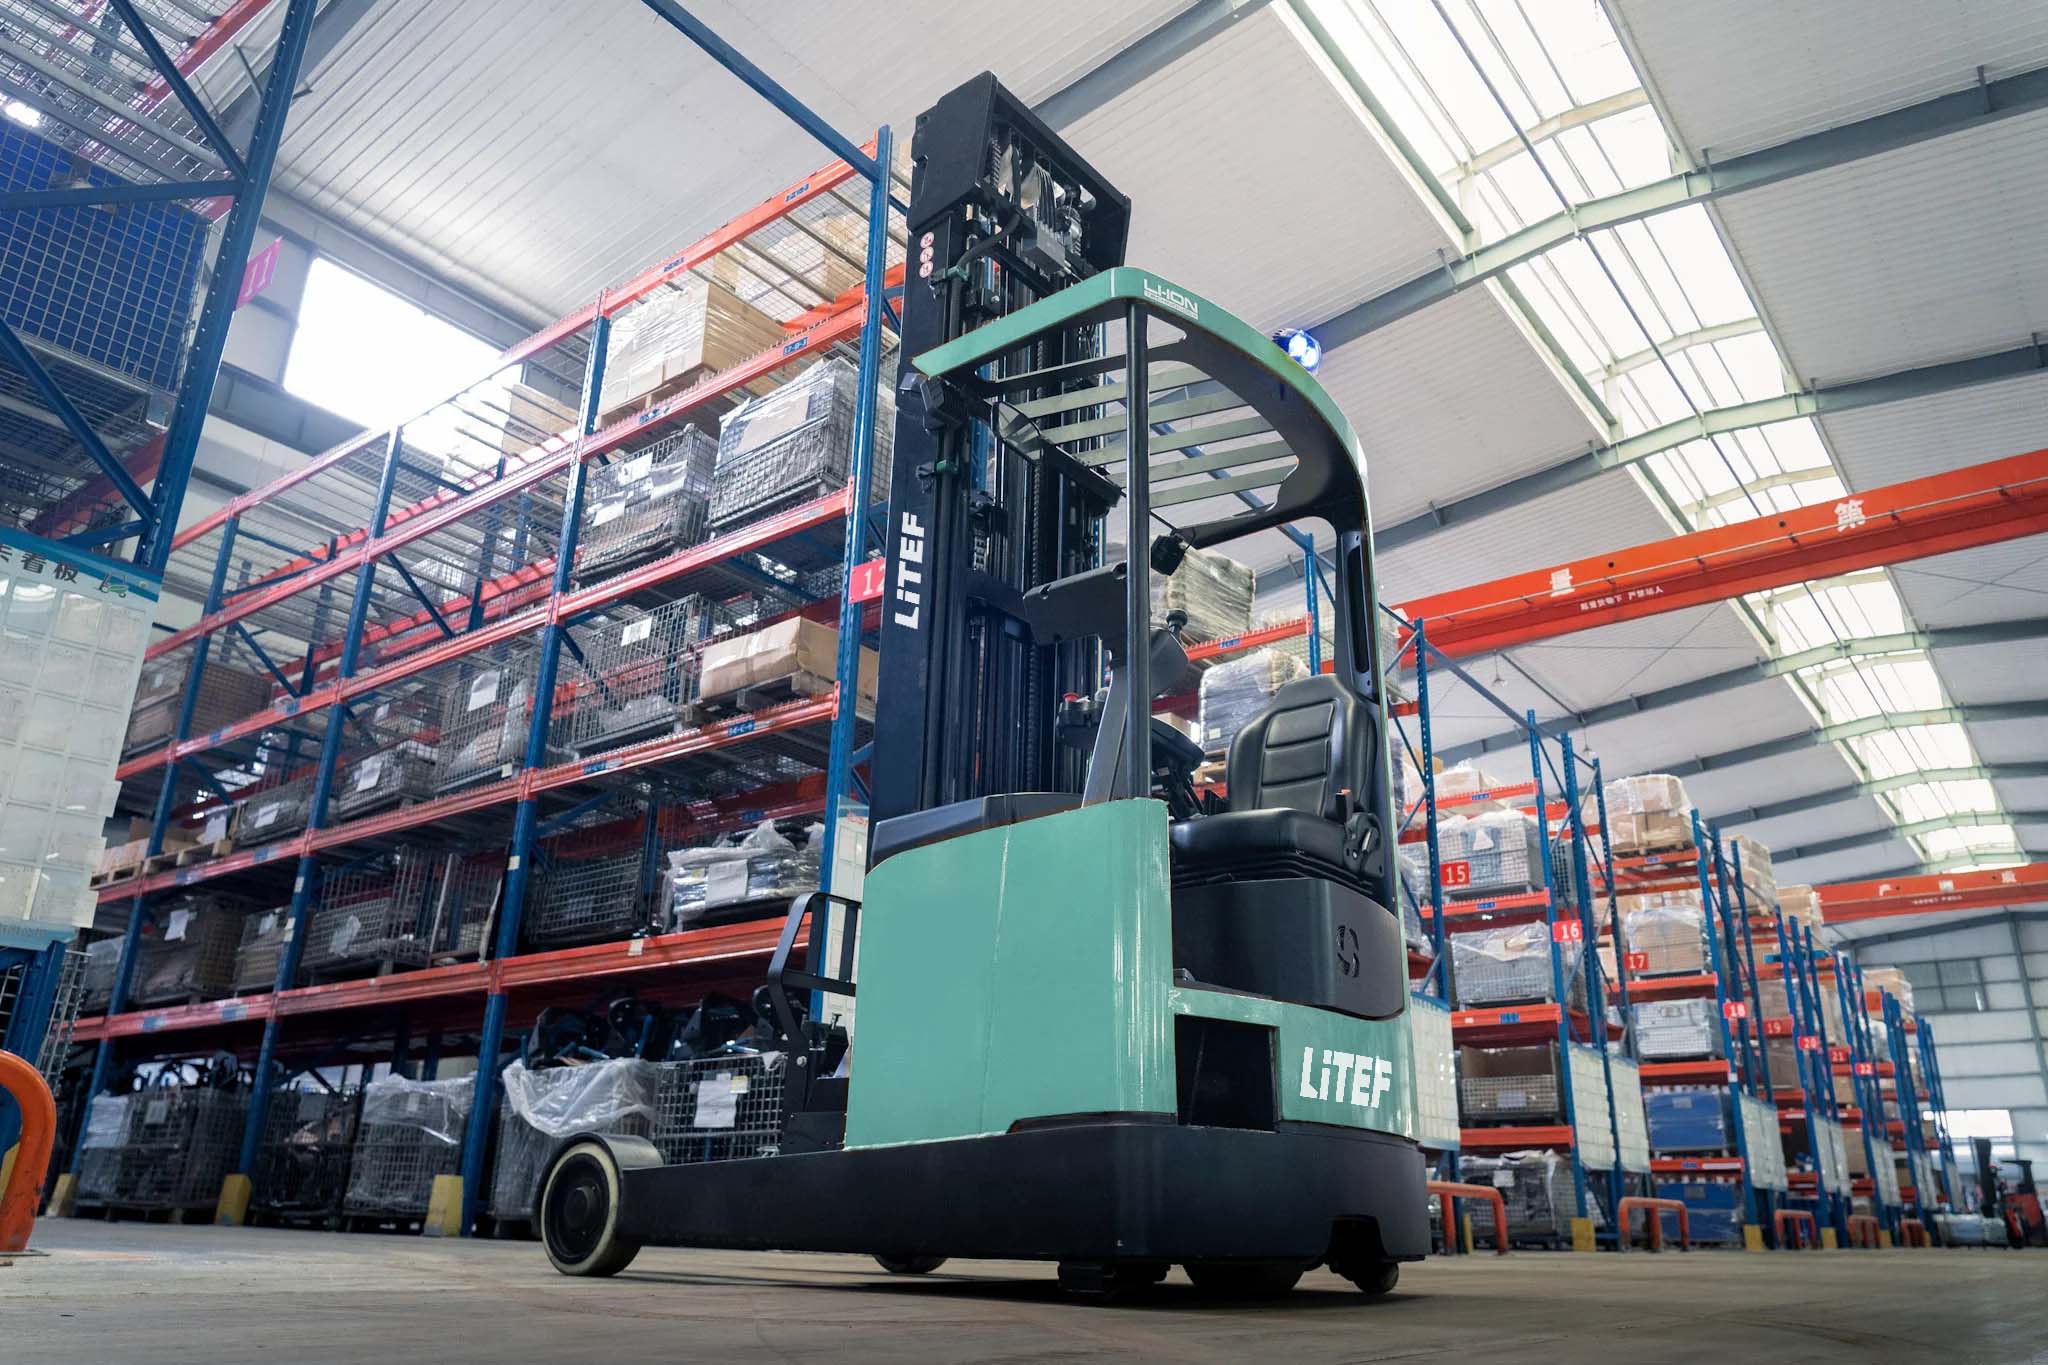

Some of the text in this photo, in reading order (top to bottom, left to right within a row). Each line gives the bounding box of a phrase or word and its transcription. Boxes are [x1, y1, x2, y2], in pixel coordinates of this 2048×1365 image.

[244, 250, 272, 297] 11
[1445, 864, 1467, 884] 15
[1561, 922, 1580, 939] 16
[1629, 954, 1645, 969] 17
[1730, 1003, 1746, 1017] 18
[1766, 1020, 1781, 1034] 19
